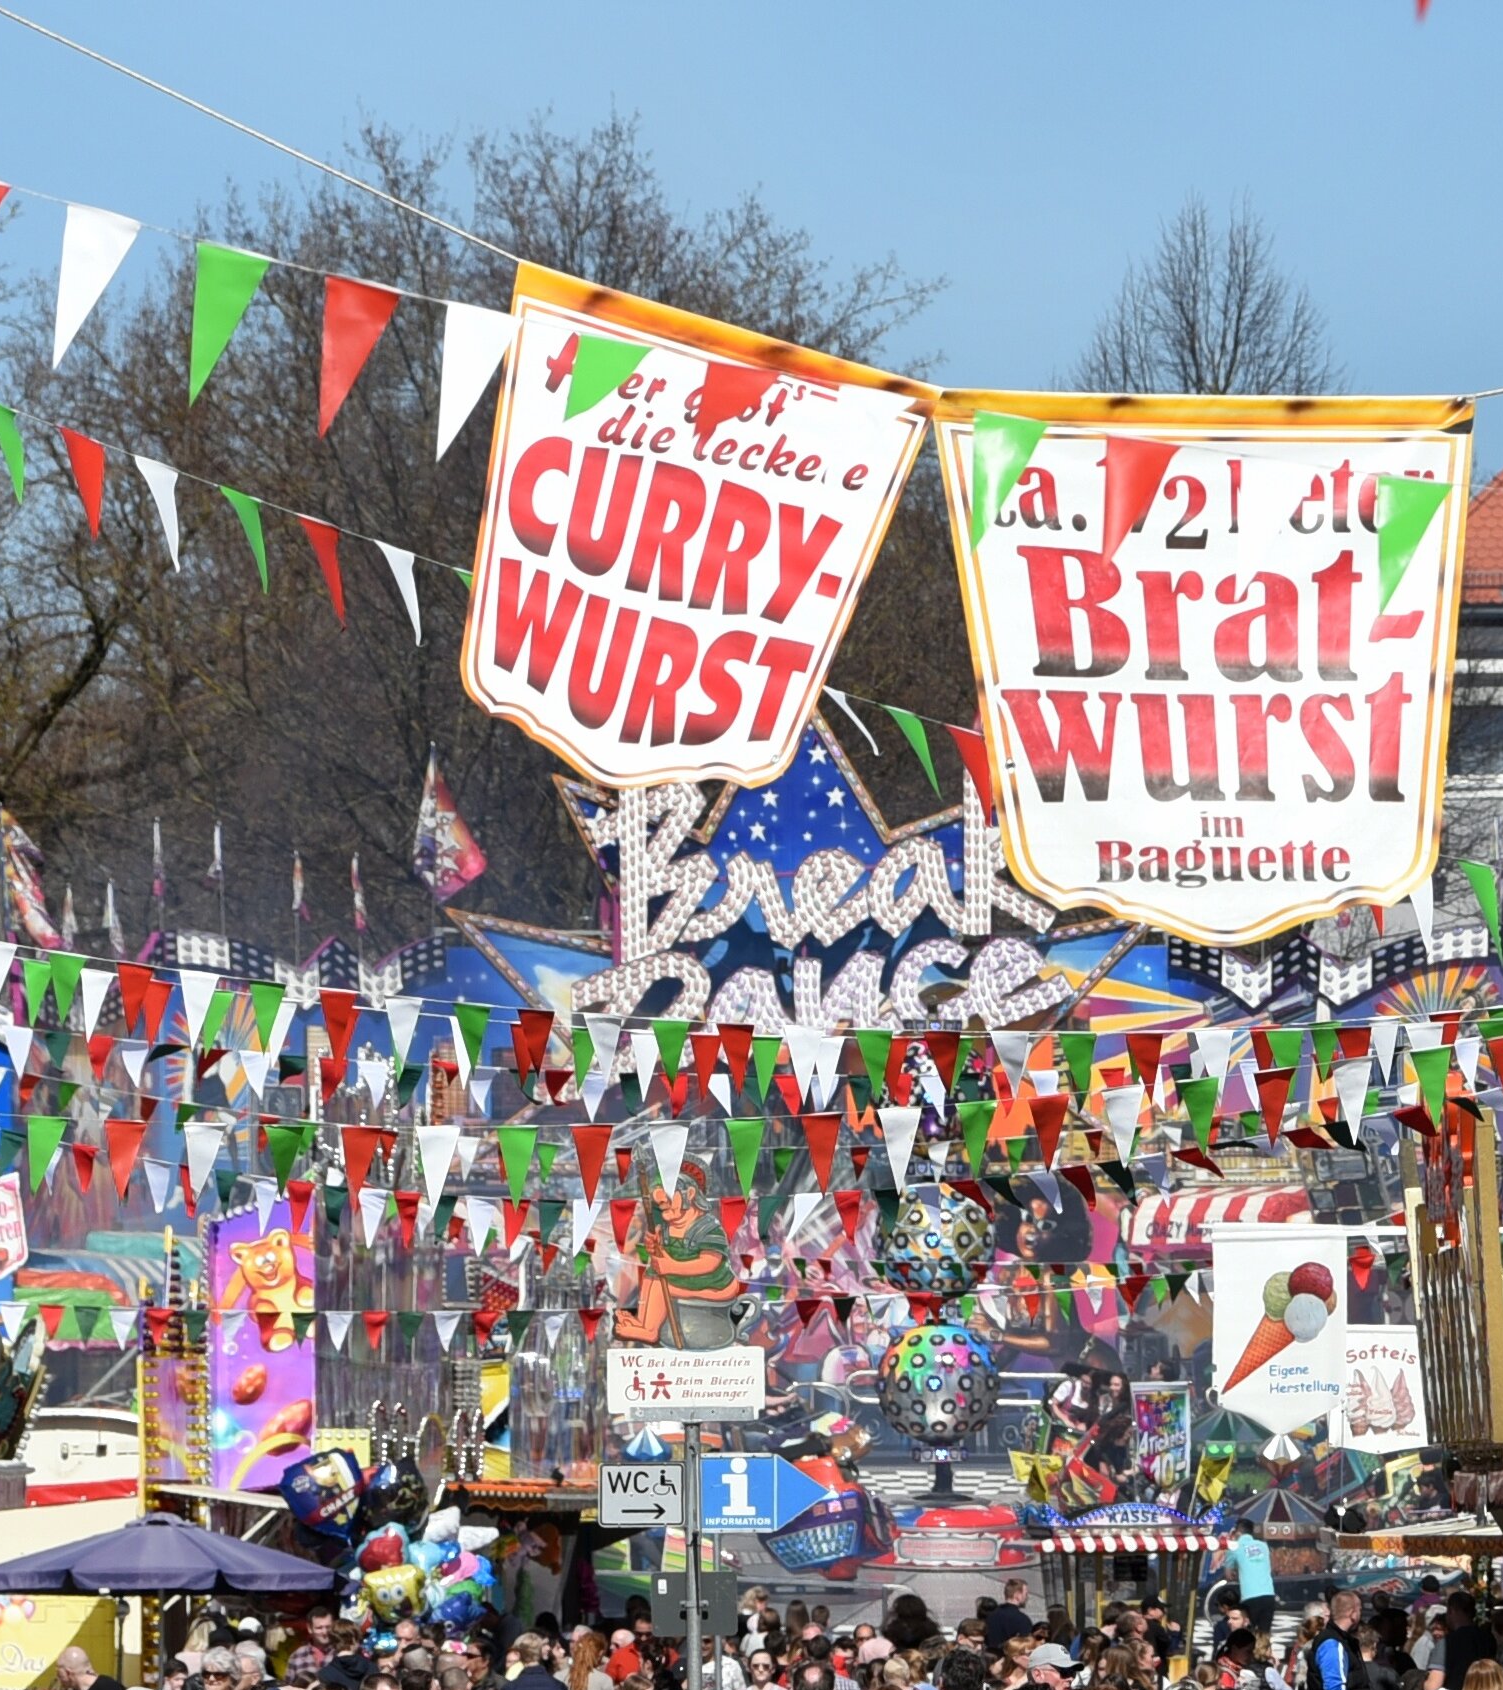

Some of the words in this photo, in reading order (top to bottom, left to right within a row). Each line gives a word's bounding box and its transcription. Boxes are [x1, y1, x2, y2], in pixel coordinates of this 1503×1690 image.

[598, 405, 675, 454] die
[692, 422, 869, 492] leckee
[508, 436, 844, 624] CURRY-
[1017, 546, 1425, 683] Brat-
[494, 557, 815, 747] WURST
[1001, 672, 1412, 803] wurst
[1200, 810, 1244, 839] im
[597, 766, 1057, 964] Break
[1095, 840, 1351, 888] Baguette
[620, 1355, 644, 1368] WC
[647, 1358, 666, 1368] Bei
[670, 1356, 690, 1367] den
[1346, 1344, 1417, 1365] Softeis
[675, 1376, 704, 1386] Beim
[1269, 1364, 1309, 1377] Eigene
[681, 1389, 749, 1401] Binswanger
[1269, 1380, 1340, 1396] Herstellung
[608, 1471, 650, 1494] WC
[705, 1517, 772, 1526] INFORMATION
[1108, 1507, 1160, 1524] KASSE
